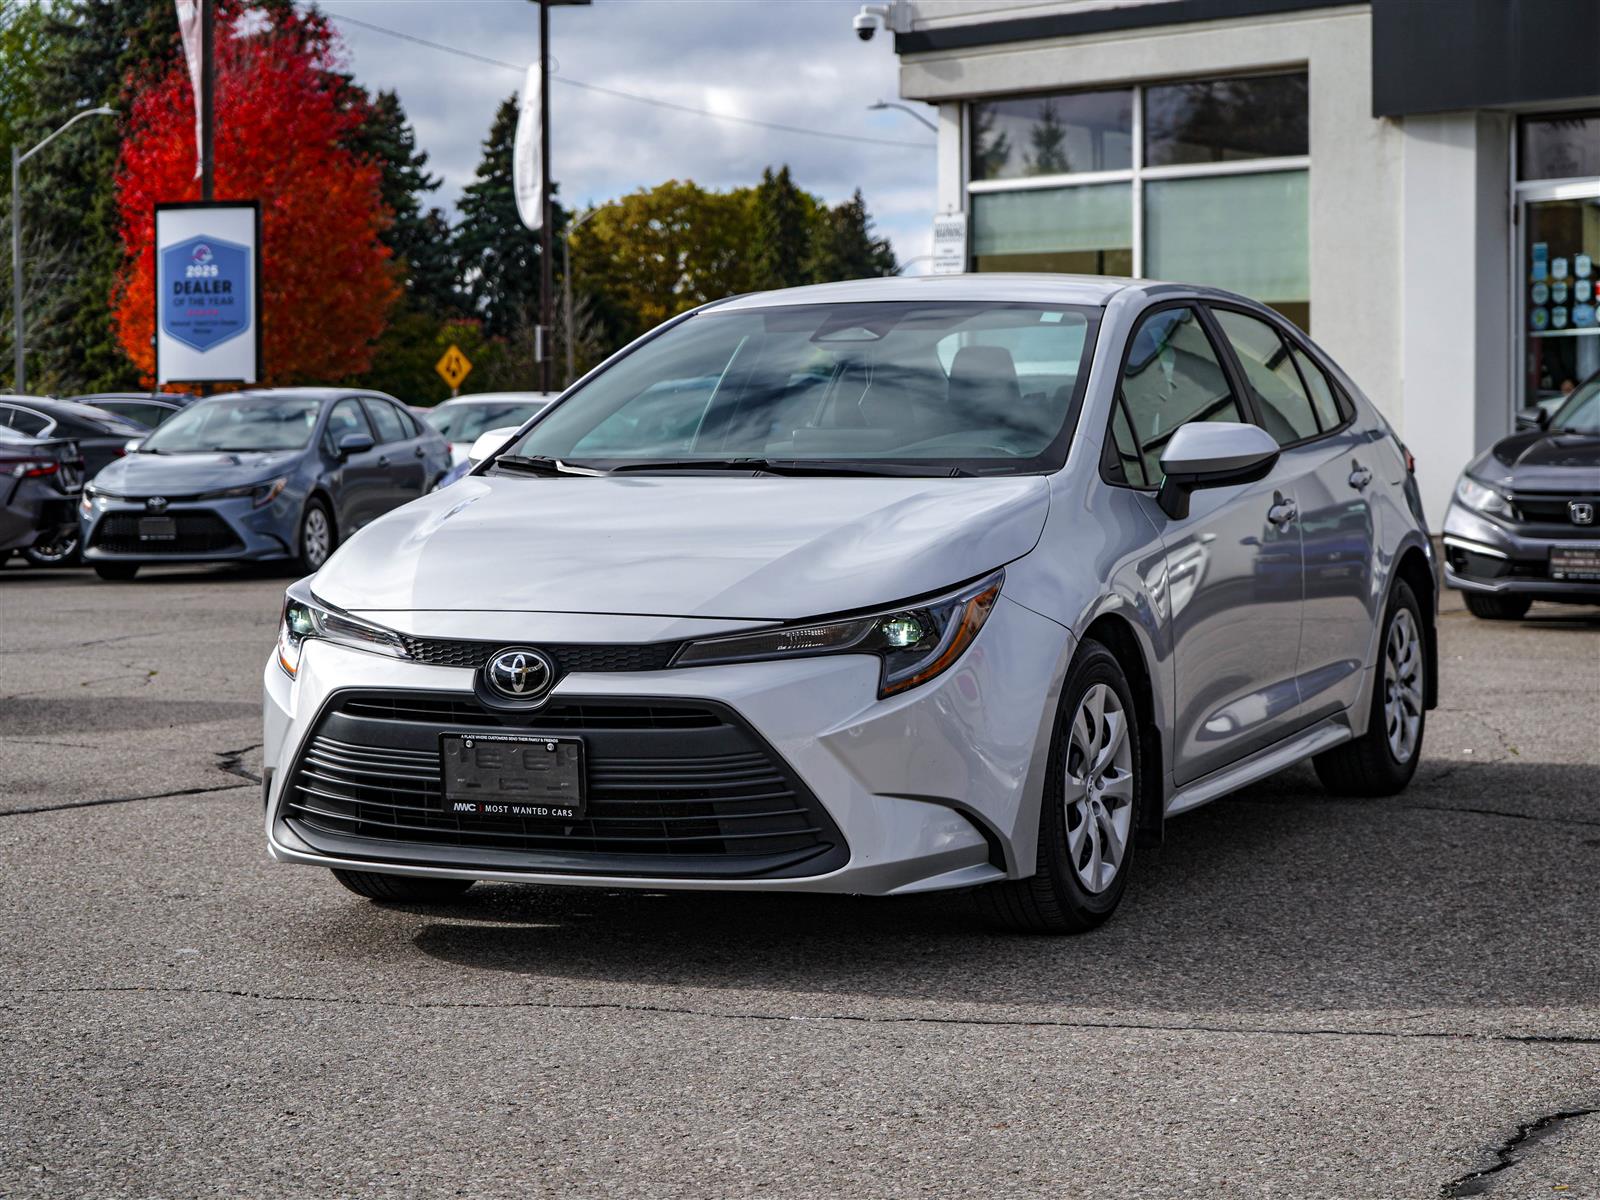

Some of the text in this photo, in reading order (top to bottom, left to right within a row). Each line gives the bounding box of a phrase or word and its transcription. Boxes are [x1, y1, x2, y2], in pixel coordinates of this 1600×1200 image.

[186, 264, 218, 278] 2025
[173, 280, 233, 295] DEALER
[173, 296, 234, 306] OF THE YEAR
[485, 804, 509, 813] MOST
[512, 806, 548, 815] WANTED
[551, 808, 573, 817] CARS
